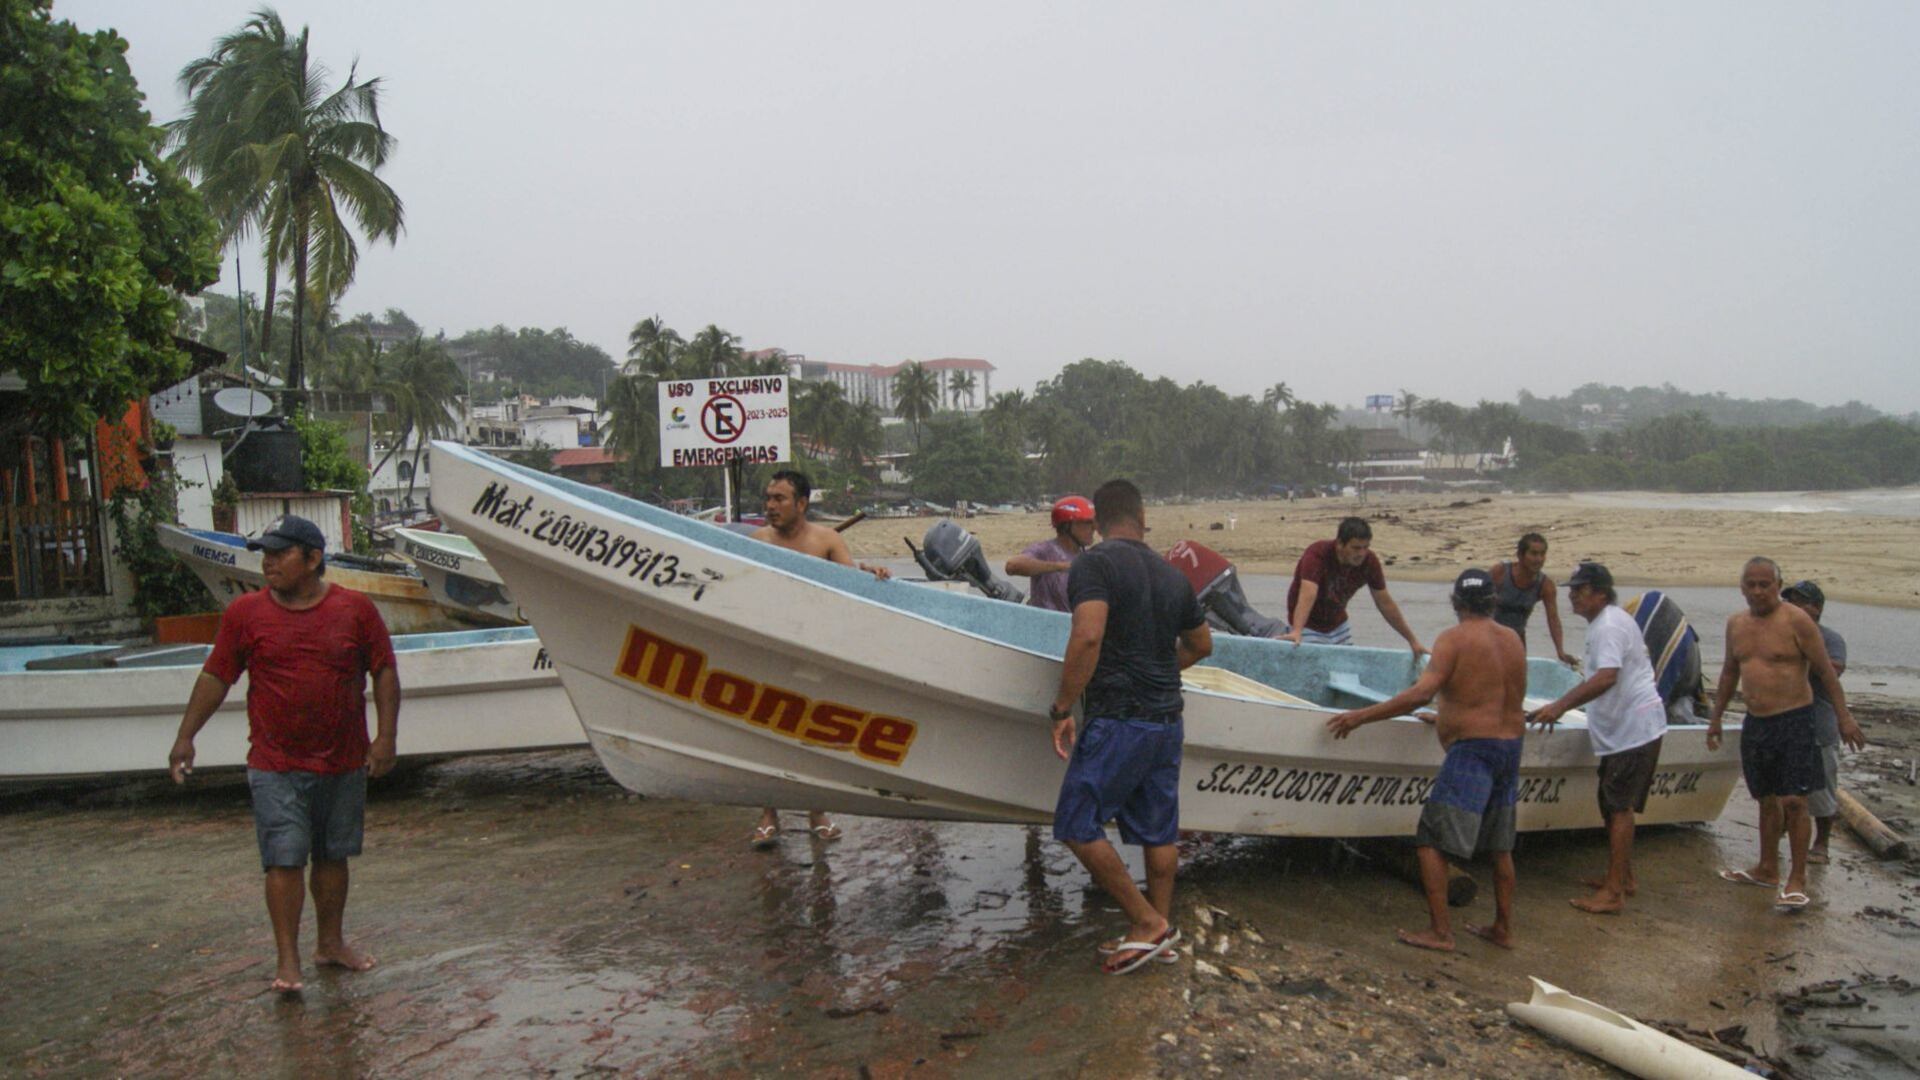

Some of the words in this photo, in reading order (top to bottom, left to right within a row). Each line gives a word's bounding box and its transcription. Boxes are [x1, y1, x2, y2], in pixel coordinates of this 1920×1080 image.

[668, 382, 694, 398] USO
[709, 377, 782, 396] EXCLUSIVO
[746, 407, 788, 420] 2023-2025
[673, 445, 778, 467] EMERGENCIAS
[192, 544, 236, 566] IMEMSA
[614, 624, 918, 767] Monse
[1271, 768, 1343, 805] COSTA
[1336, 774, 1371, 805] DE
